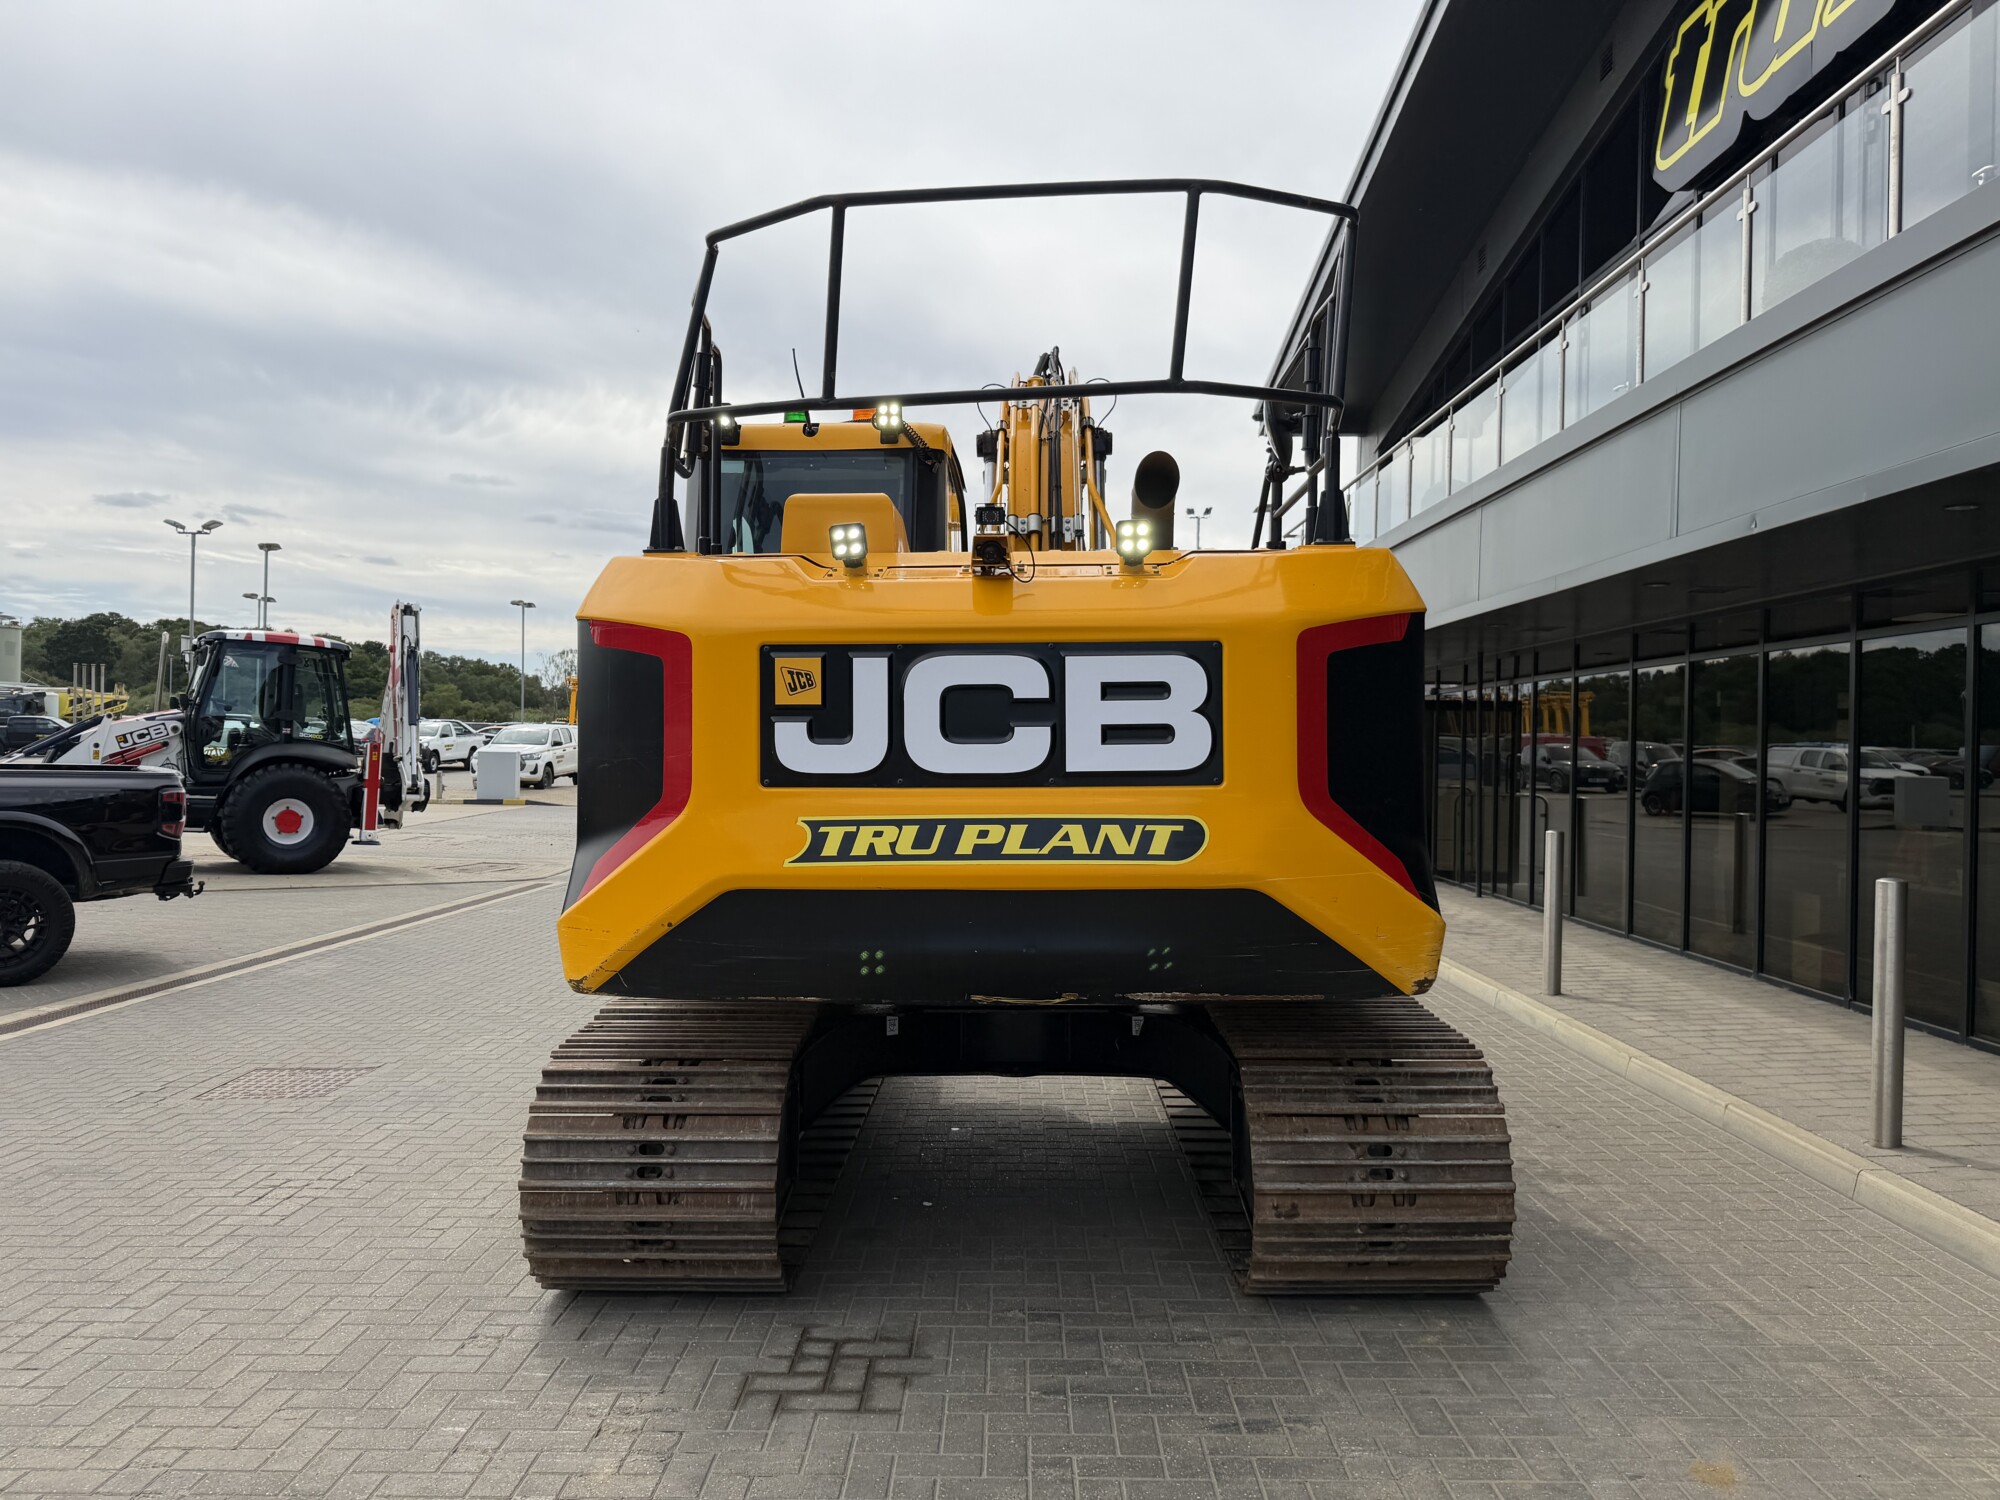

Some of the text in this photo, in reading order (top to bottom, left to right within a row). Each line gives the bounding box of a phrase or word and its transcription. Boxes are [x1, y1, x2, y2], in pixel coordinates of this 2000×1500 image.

[786, 669, 815, 693] JCB
[774, 654, 1213, 774] JCB
[118, 723, 169, 747] JCB
[817, 824, 1184, 856] TRU PLANT
